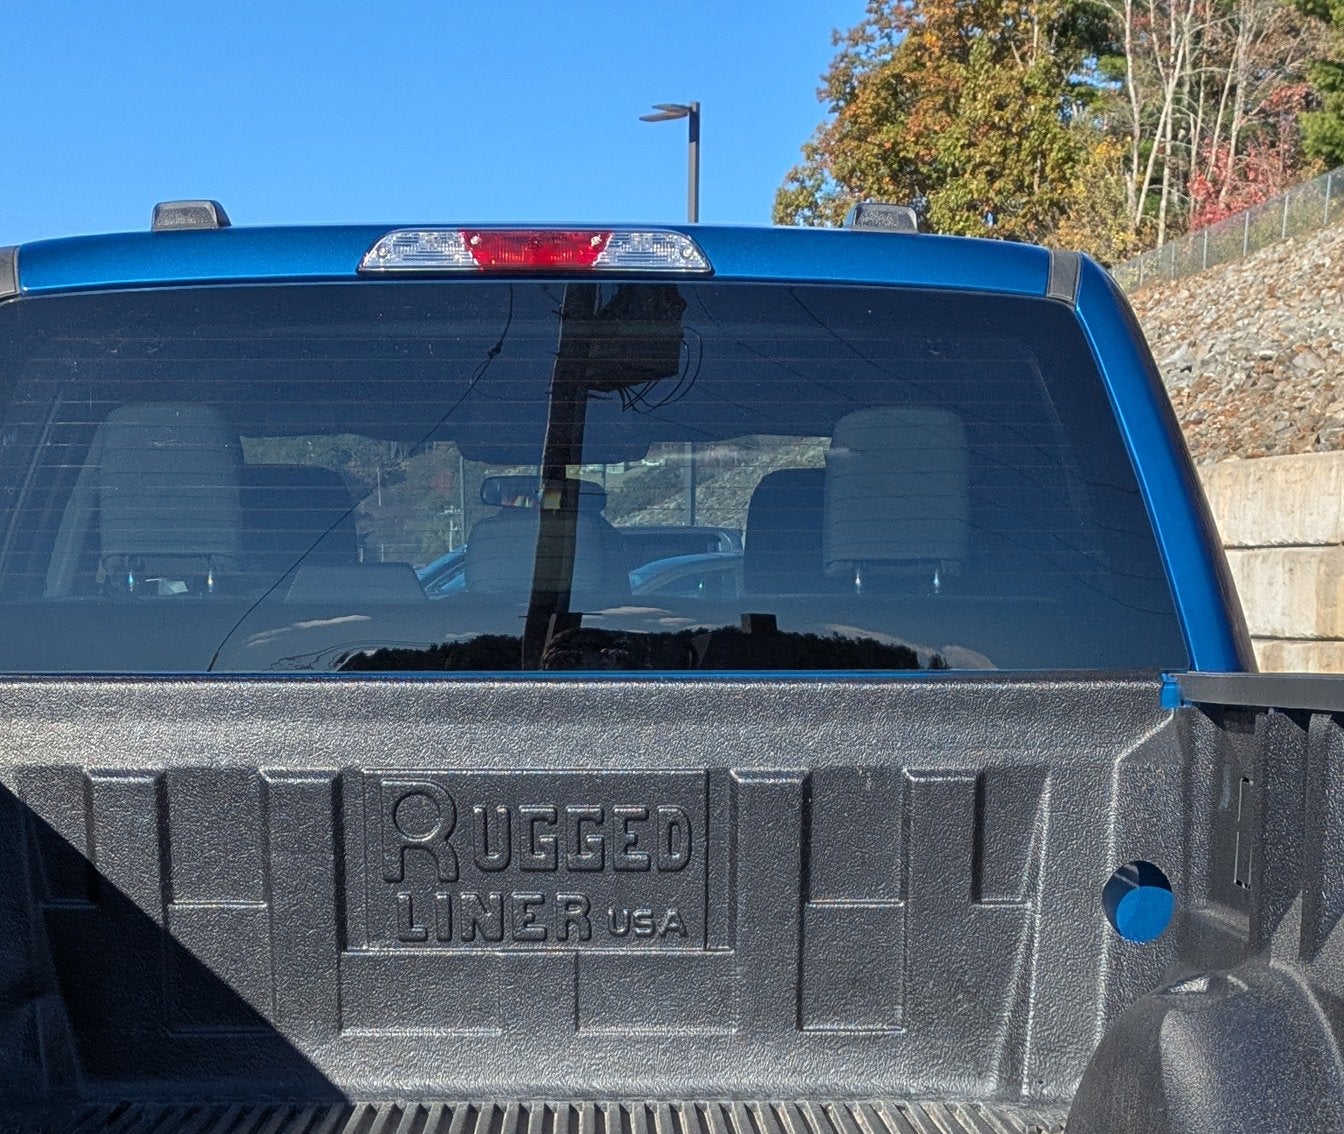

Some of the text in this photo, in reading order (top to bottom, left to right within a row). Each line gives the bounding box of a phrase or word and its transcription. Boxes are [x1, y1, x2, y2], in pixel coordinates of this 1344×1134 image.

[380, 778, 693, 883] RUGGED
[397, 890, 688, 942] LINER USA
